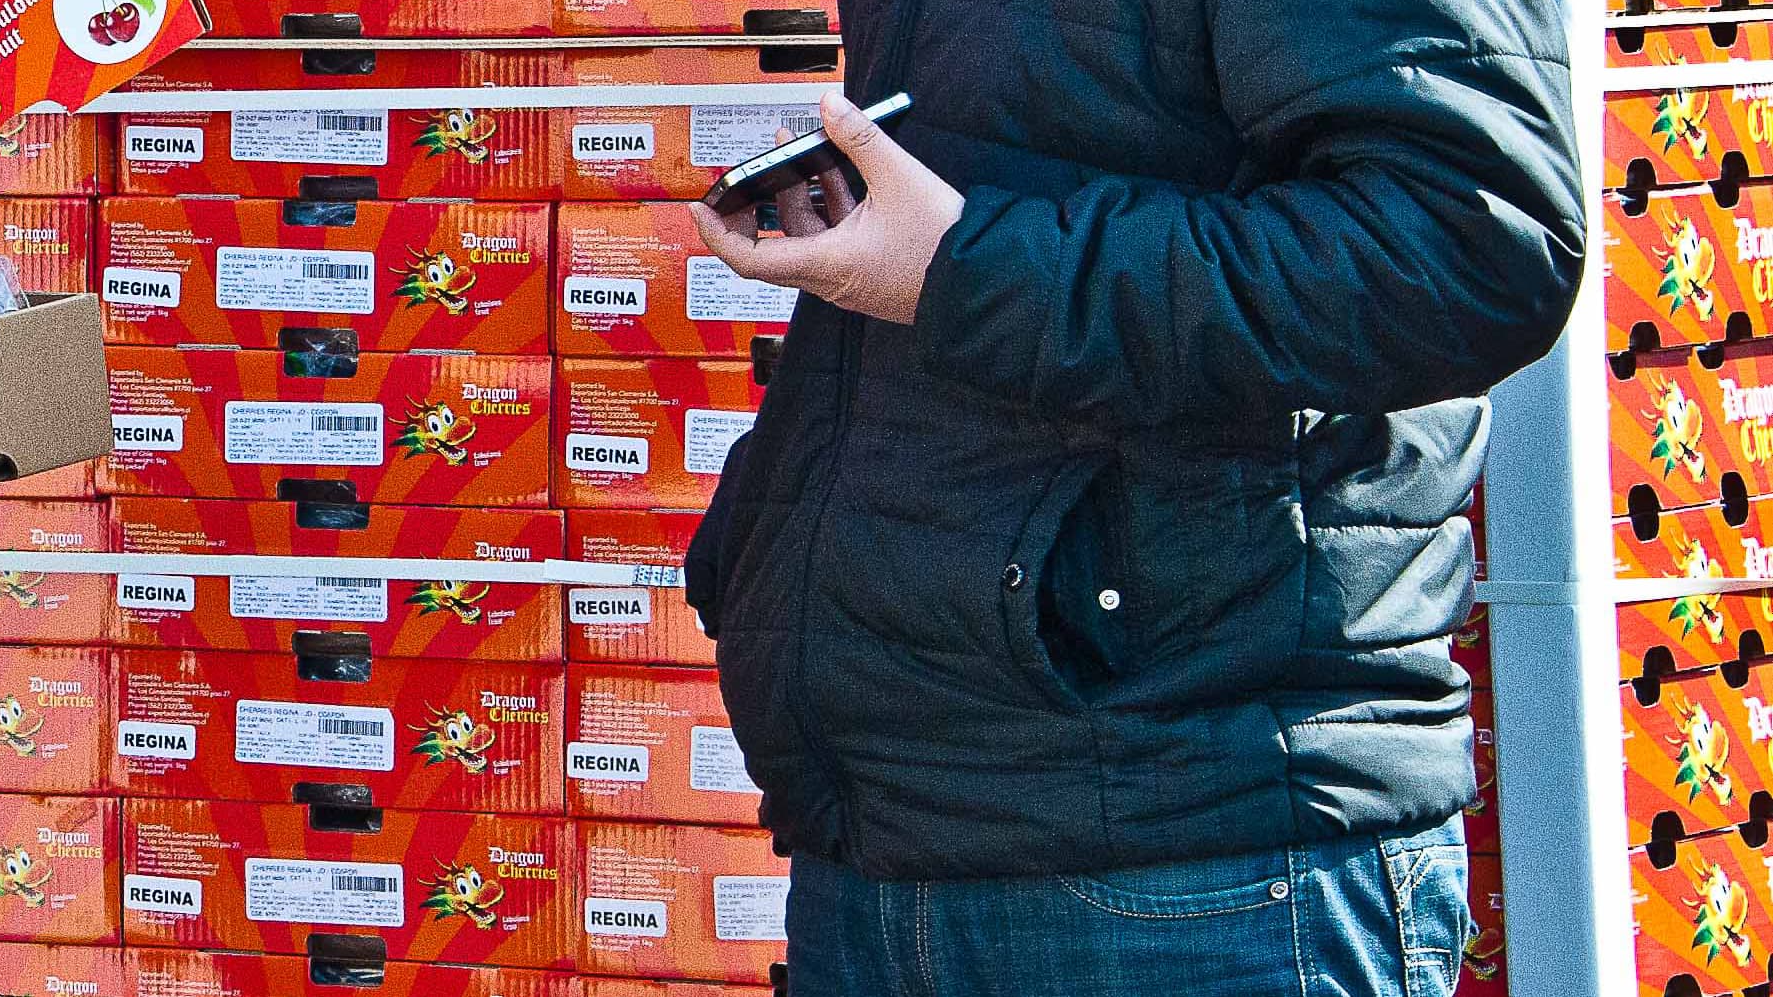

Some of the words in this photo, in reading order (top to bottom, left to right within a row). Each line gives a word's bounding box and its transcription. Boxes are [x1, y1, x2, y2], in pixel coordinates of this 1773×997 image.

[132, 138, 195, 153] REGINA
[579, 137, 645, 151] REGINA
[461, 233, 517, 250] Dragon
[469, 248, 530, 264] Cherries
[109, 280, 171, 298] REGINA
[573, 447, 639, 464] REGINA
[481, 692, 535, 708] Dragon
[488, 708, 549, 724] Cherries
[574, 755, 640, 772] REGINA
[131, 888, 193, 906] REGINA
[592, 911, 658, 928] REGINA
